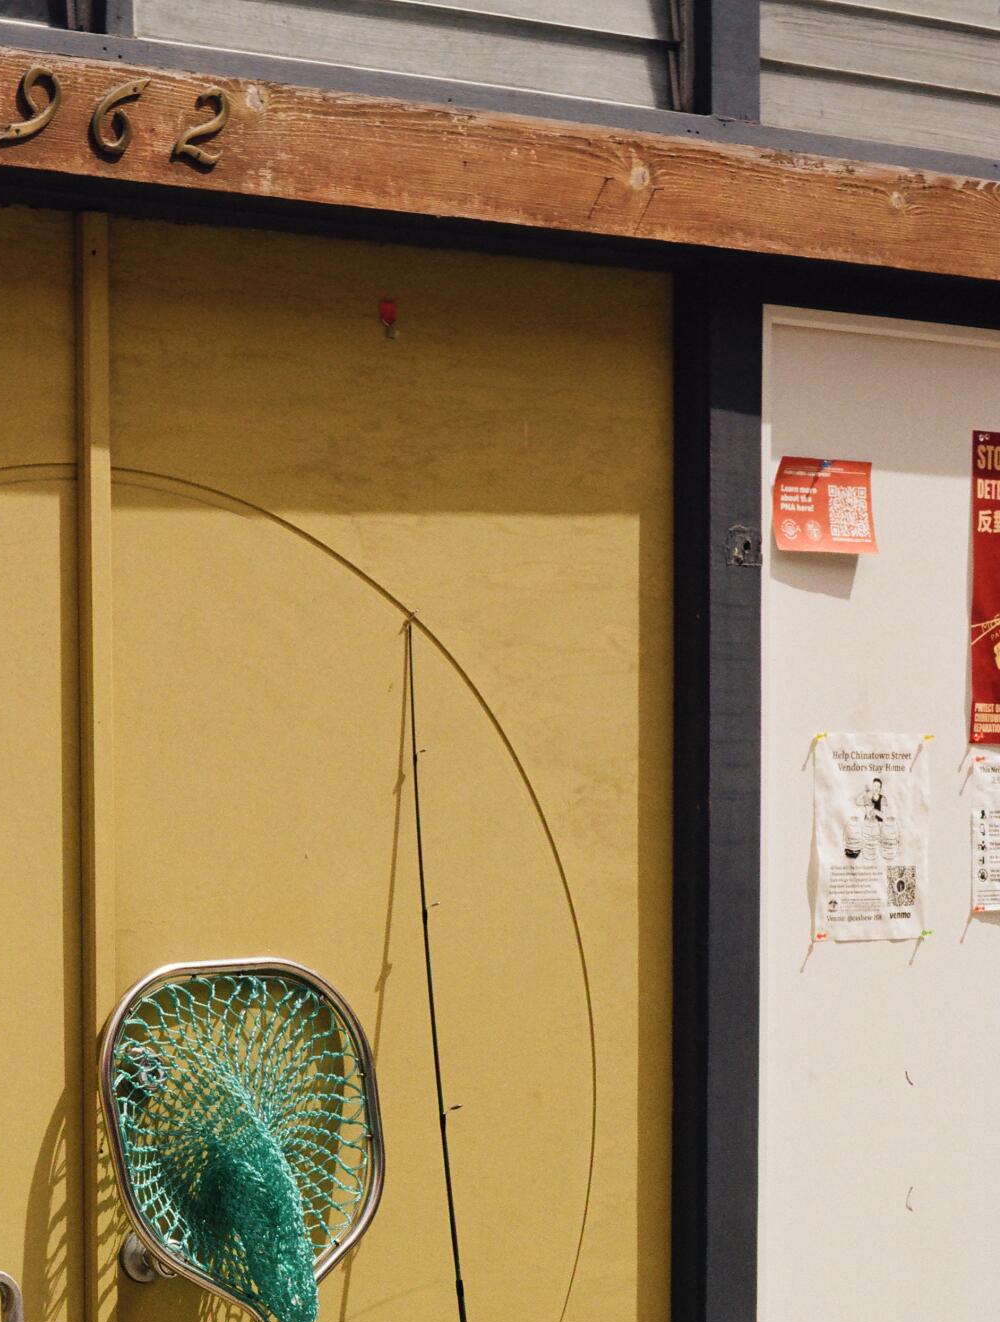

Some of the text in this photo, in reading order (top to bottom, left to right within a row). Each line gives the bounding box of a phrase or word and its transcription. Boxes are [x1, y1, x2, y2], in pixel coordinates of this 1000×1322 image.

[977, 444, 1000, 470] STO
[780, 484, 799, 493] Learn
[780, 493, 799, 502] about
[832, 750, 912, 761] Help Chinatown Street
[838, 762, 906, 774] Vendors Stay Home
